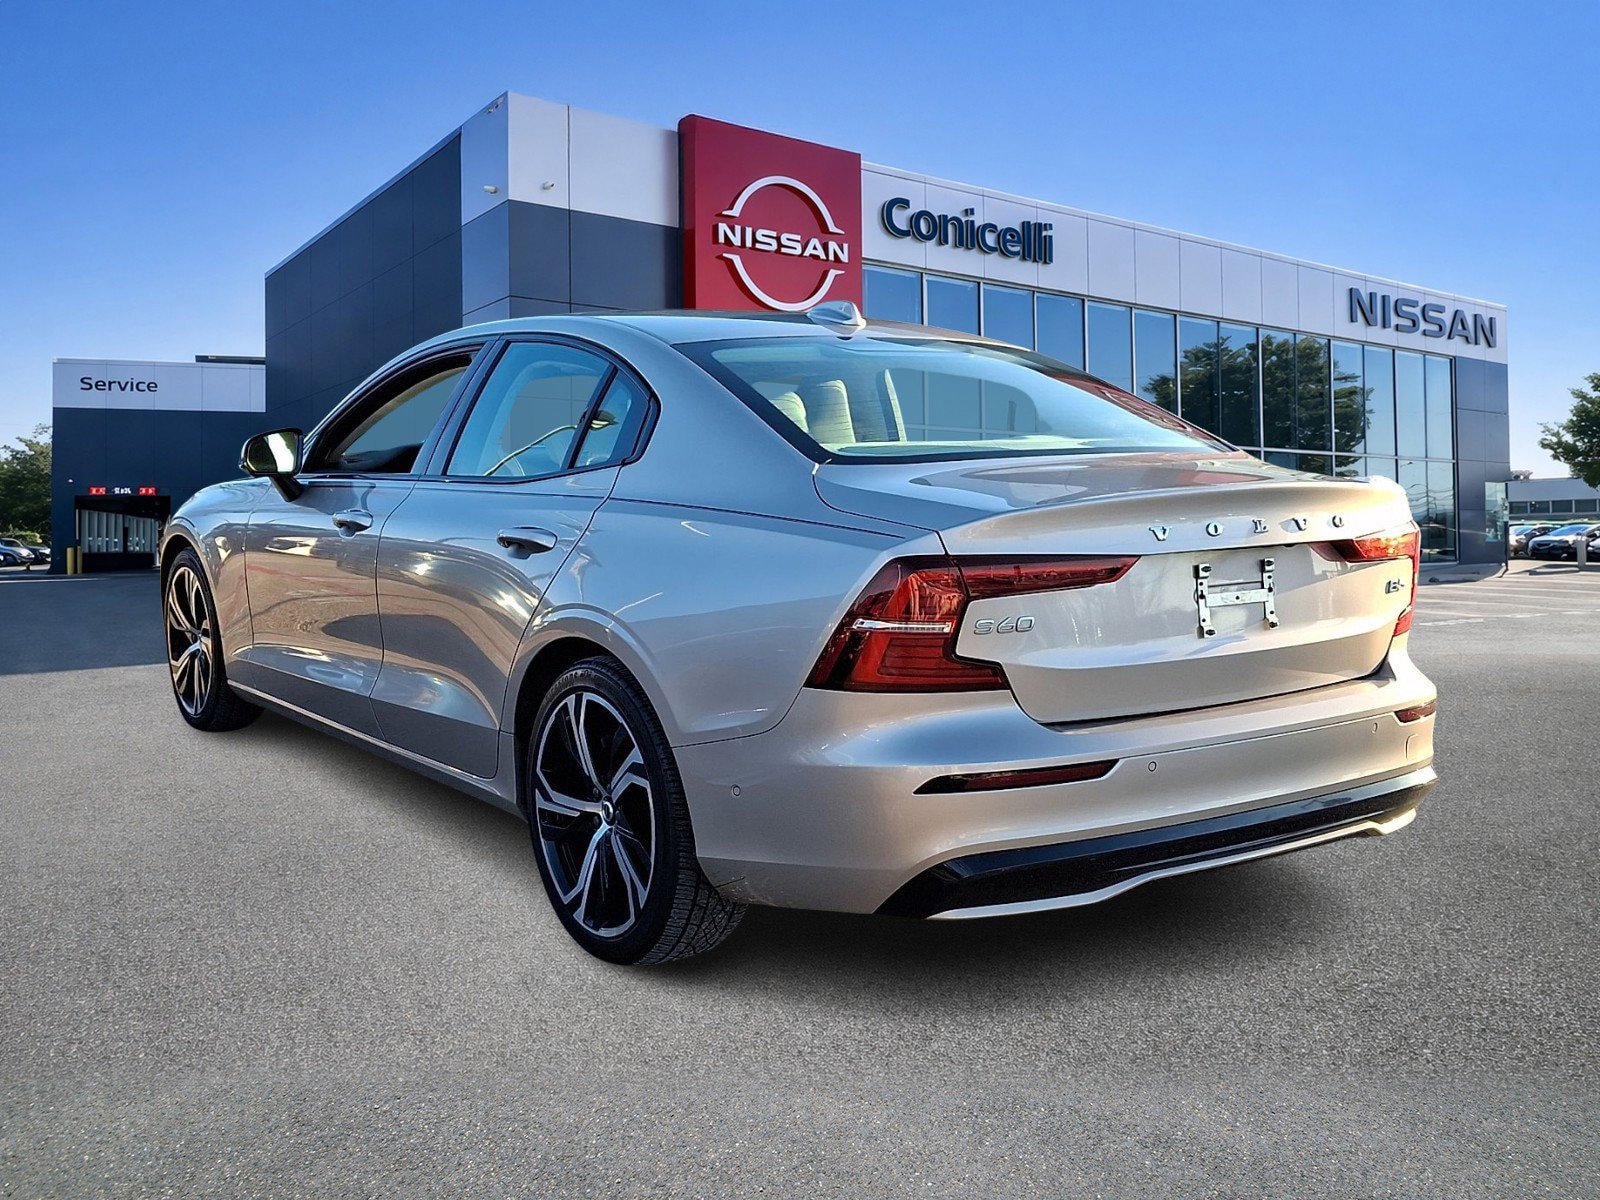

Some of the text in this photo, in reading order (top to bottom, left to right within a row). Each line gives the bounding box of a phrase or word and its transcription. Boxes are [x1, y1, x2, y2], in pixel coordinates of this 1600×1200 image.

[717, 222, 849, 263] NISSAN
[882, 197, 1053, 264] Conicelli
[1349, 287, 1497, 348] NISSAN
[80, 376, 158, 393] Service
[1149, 515, 1345, 542] VOLVO
[973, 616, 1035, 635] S60
